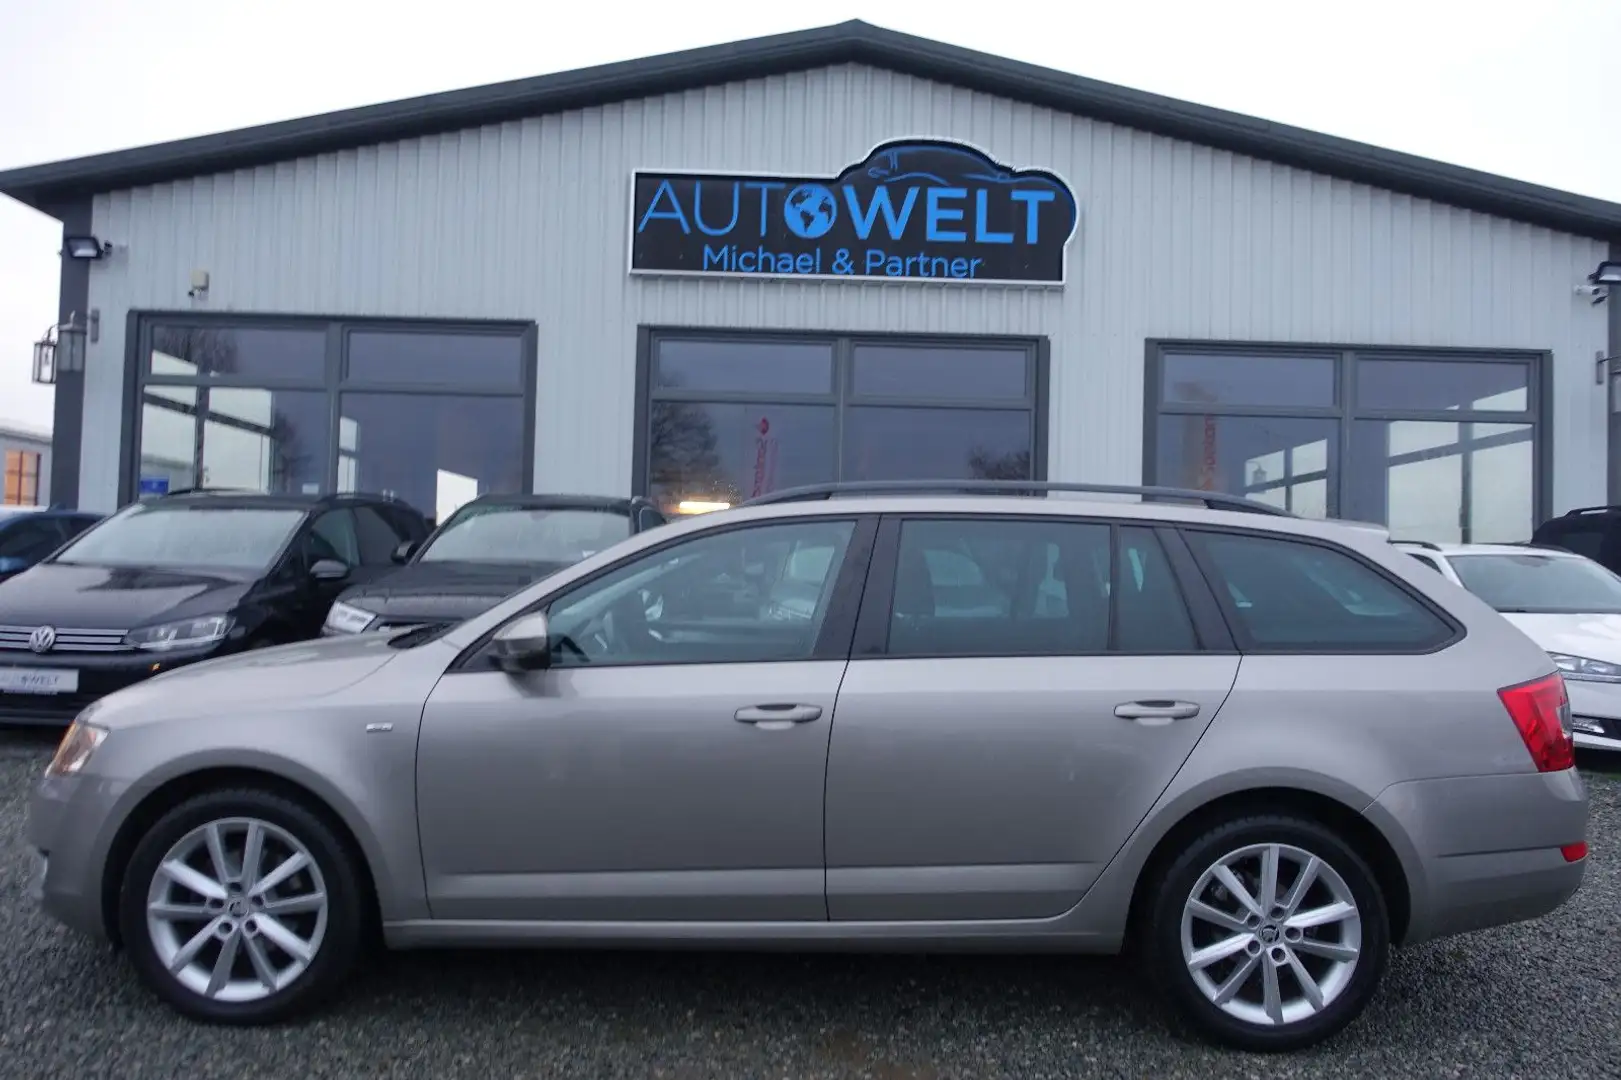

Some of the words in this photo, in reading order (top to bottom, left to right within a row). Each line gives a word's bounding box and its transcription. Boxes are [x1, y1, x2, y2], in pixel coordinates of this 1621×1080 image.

[637, 179, 1056, 245] AUTOWELT
[703, 244, 821, 274] Michael
[831, 248, 855, 275] &
[865, 249, 983, 279] Partner
